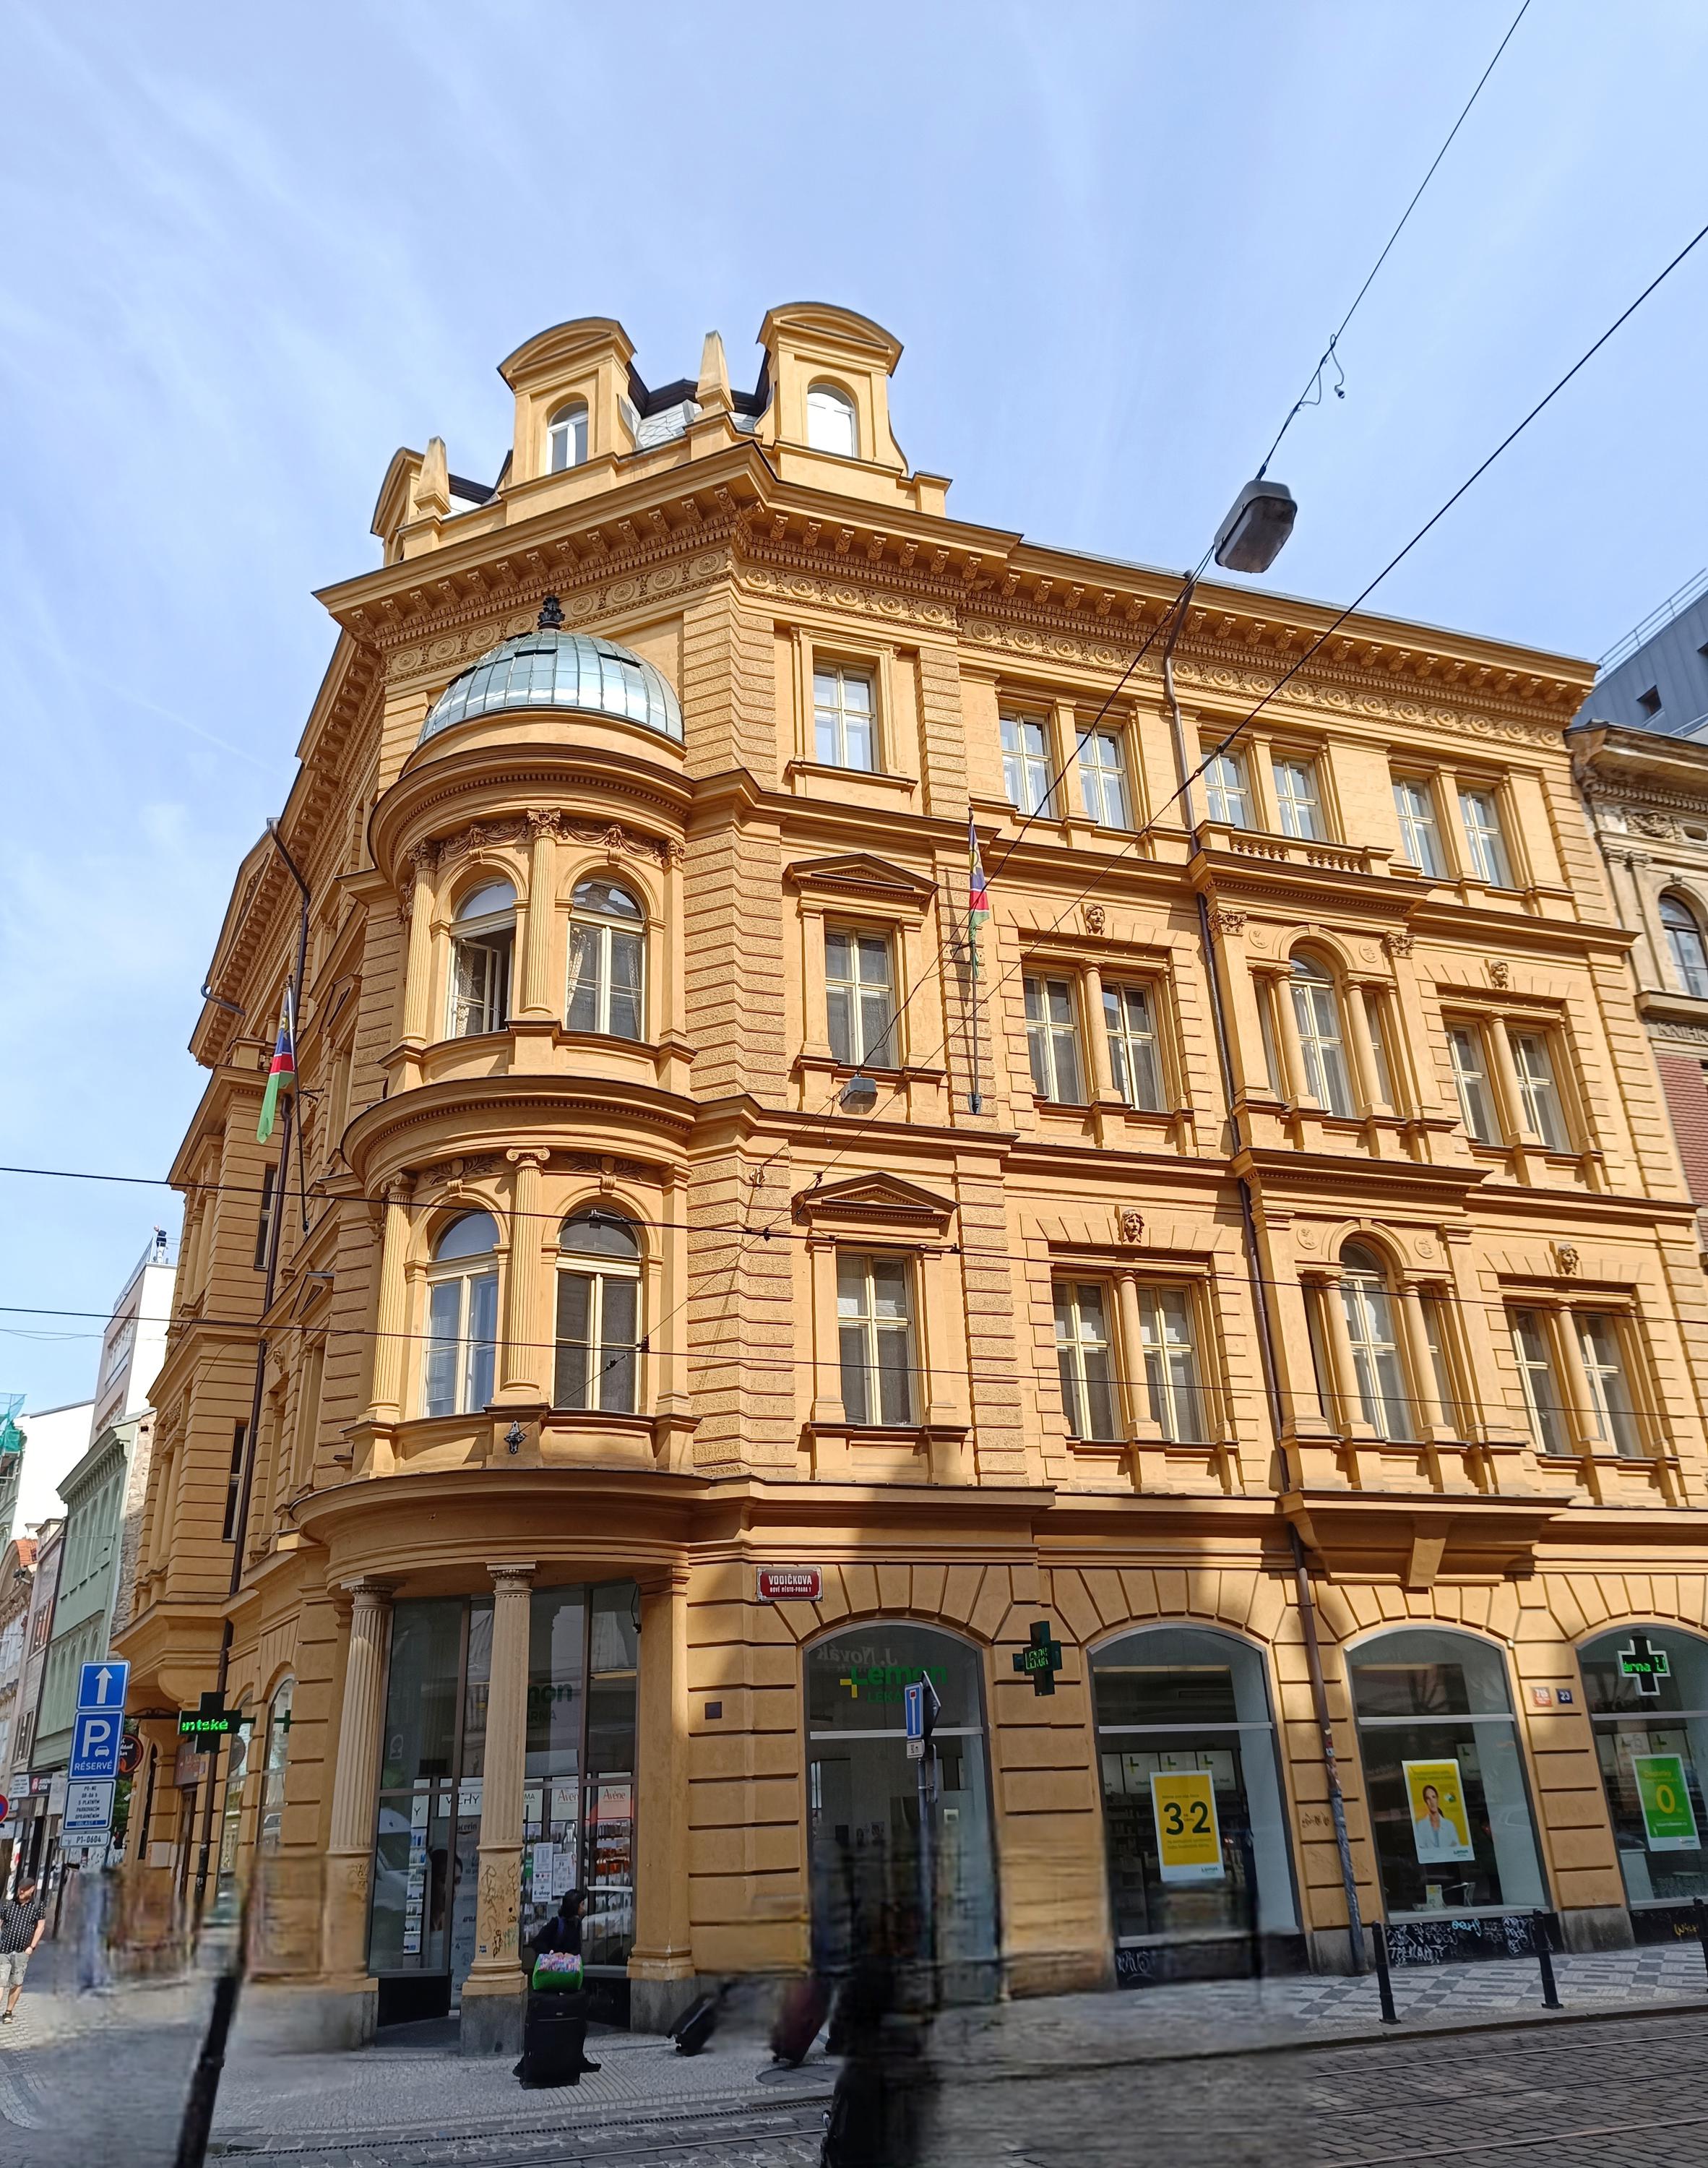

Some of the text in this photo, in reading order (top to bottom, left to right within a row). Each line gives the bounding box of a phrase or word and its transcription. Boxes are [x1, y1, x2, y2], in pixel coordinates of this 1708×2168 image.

[768, 1573, 812, 1585] VODIČKOVA
[851, 1665, 948, 1686] Lemon
[866, 1690, 904, 1703] LÉKÁ
[1559, 1690, 1571, 1701] 23
[82, 1719, 111, 1758] P
[74, 1760, 113, 1772] RÉSERVÉ
[1655, 1784, 1675, 1814] 0
